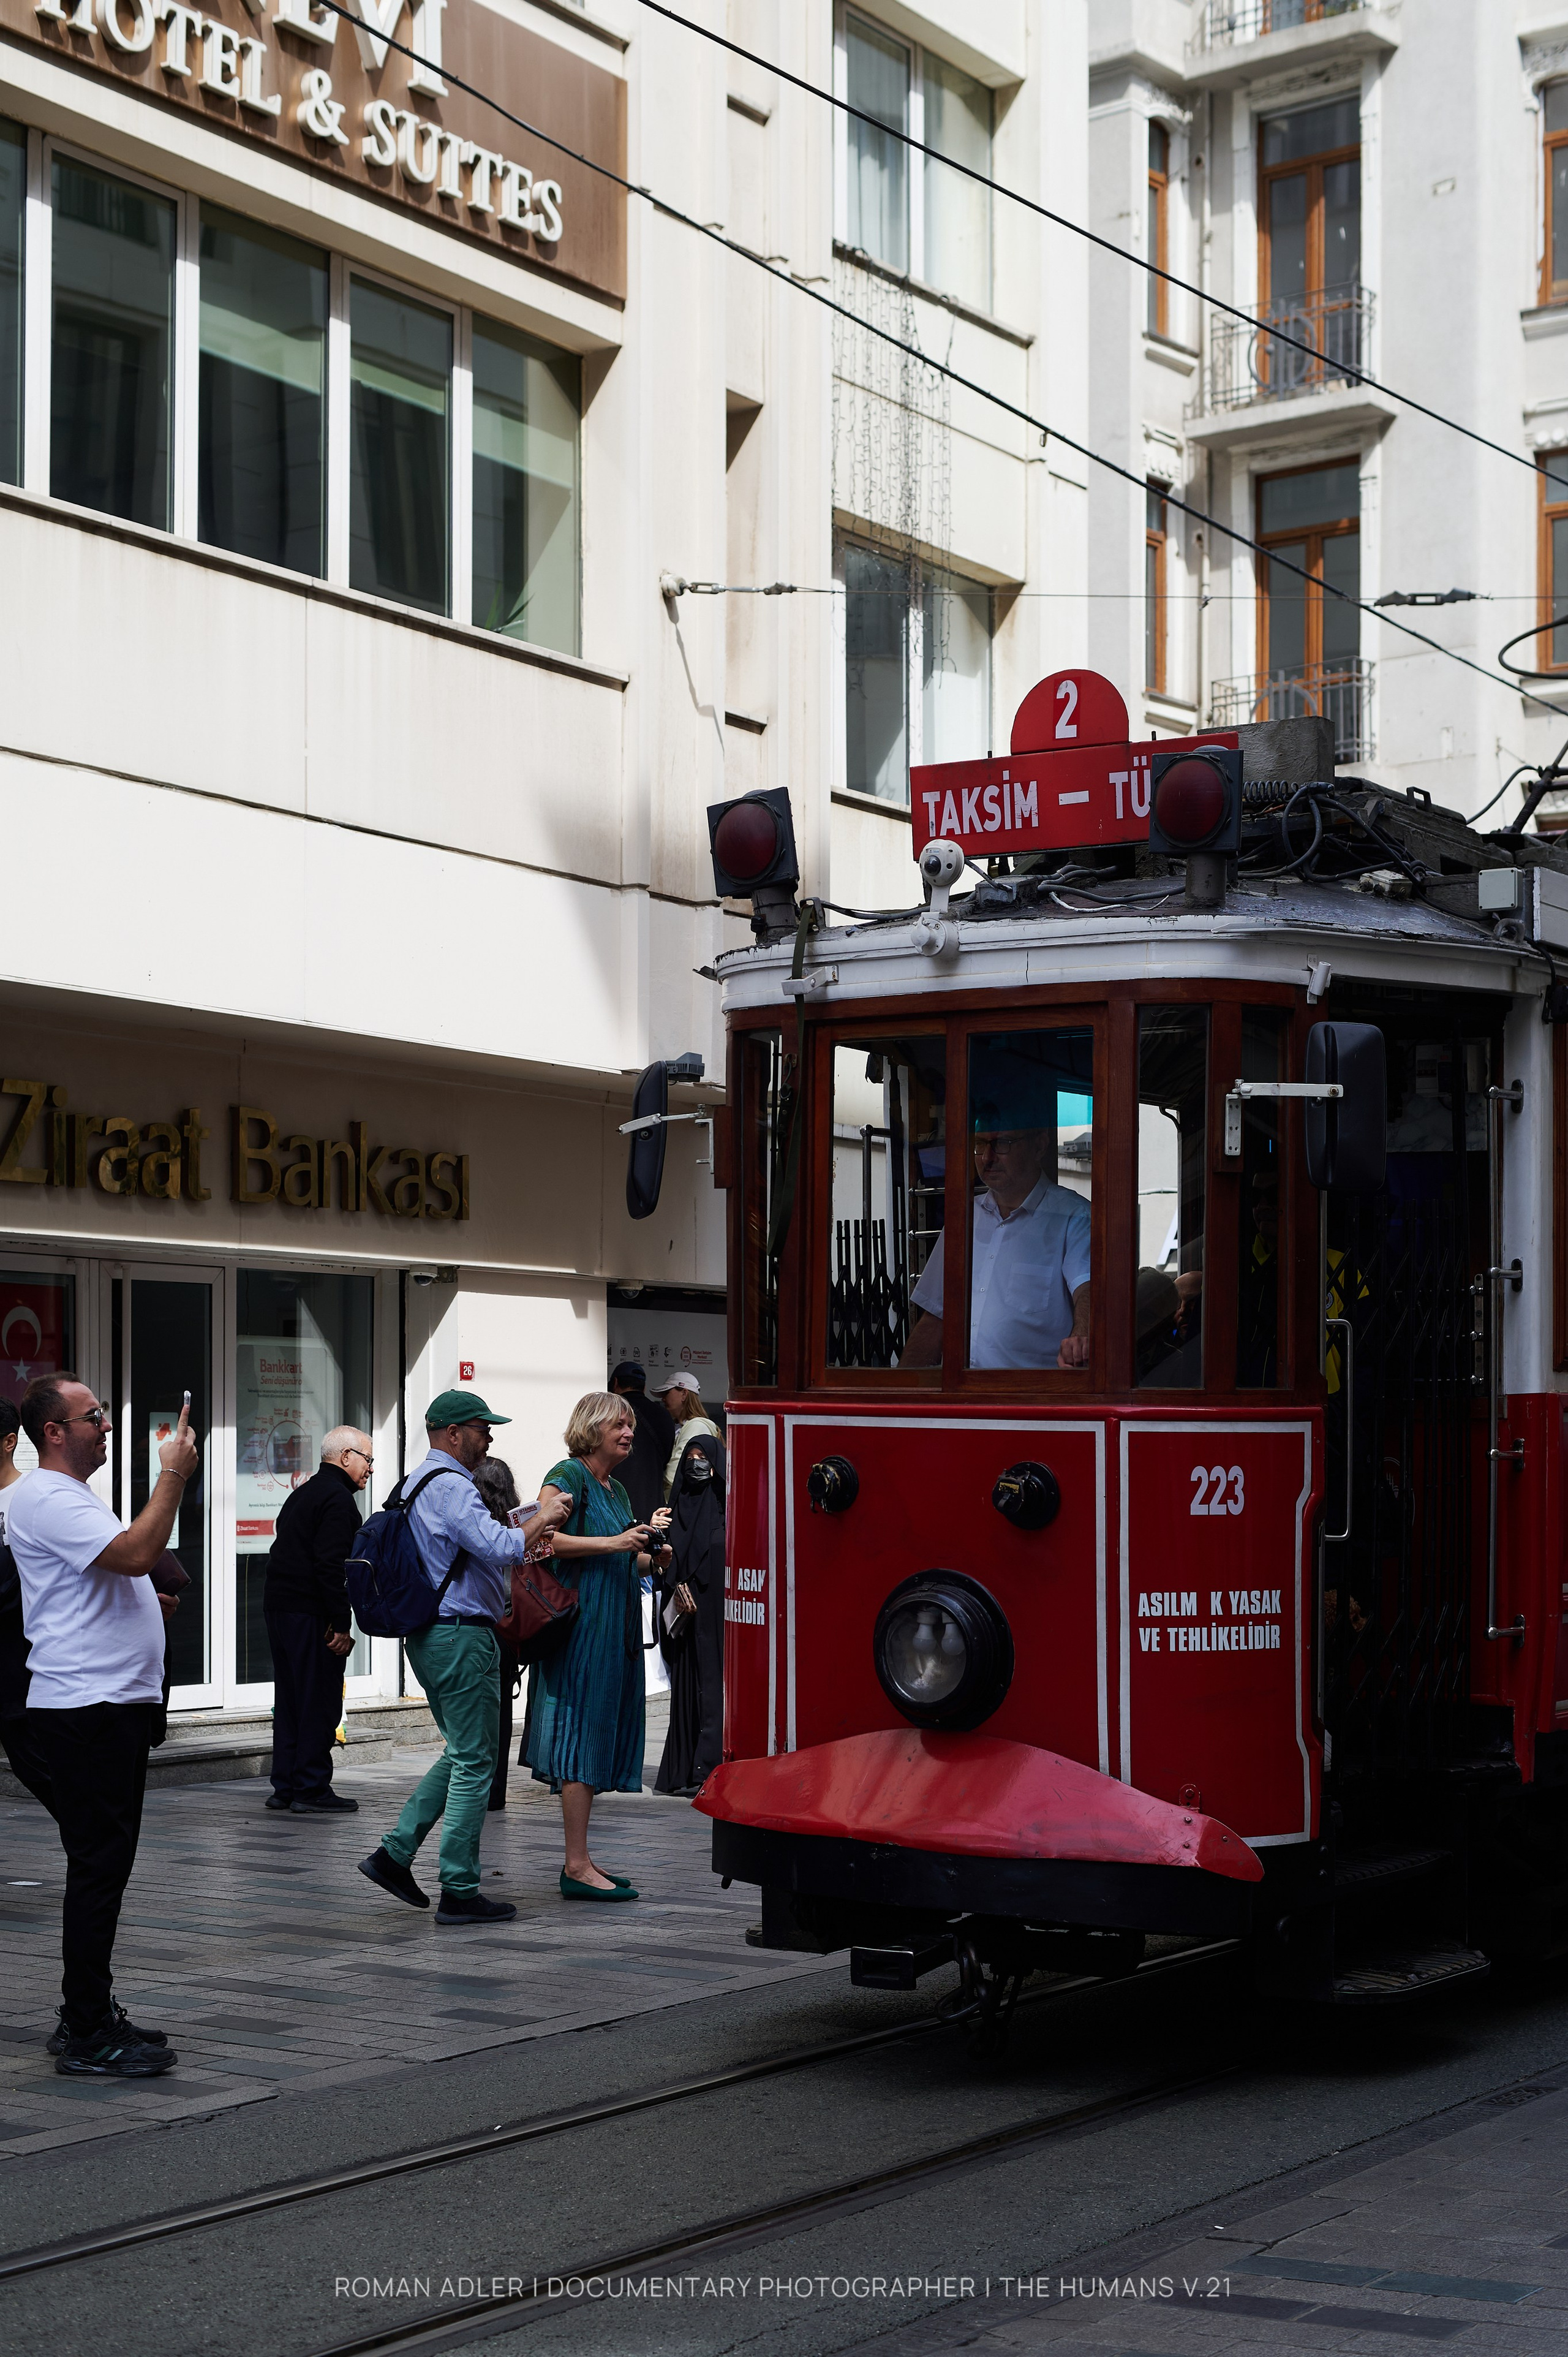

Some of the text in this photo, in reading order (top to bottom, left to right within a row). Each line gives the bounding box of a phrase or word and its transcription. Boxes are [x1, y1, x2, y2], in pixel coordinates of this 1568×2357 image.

[297, 69, 349, 145] &
[362, 99, 562, 242] SUITES
[1055, 679, 1078, 739] 2
[922, 770, 1039, 838] TAKSİM
[0, 1078, 470, 1220] Ziraat Bankası
[260, 1358, 303, 1374] Bankkart
[260, 1375, 273, 1385] Seni
[274, 1375, 297, 1387] düşünür
[463, 1365, 472, 1376] 26
[1190, 1466, 1245, 1515] 223
[1137, 1592, 1197, 1617] ASILM
[1229, 1589, 1281, 1615] YASAK
[1139, 1620, 1280, 1652] VE TEHLİKELİDİR
